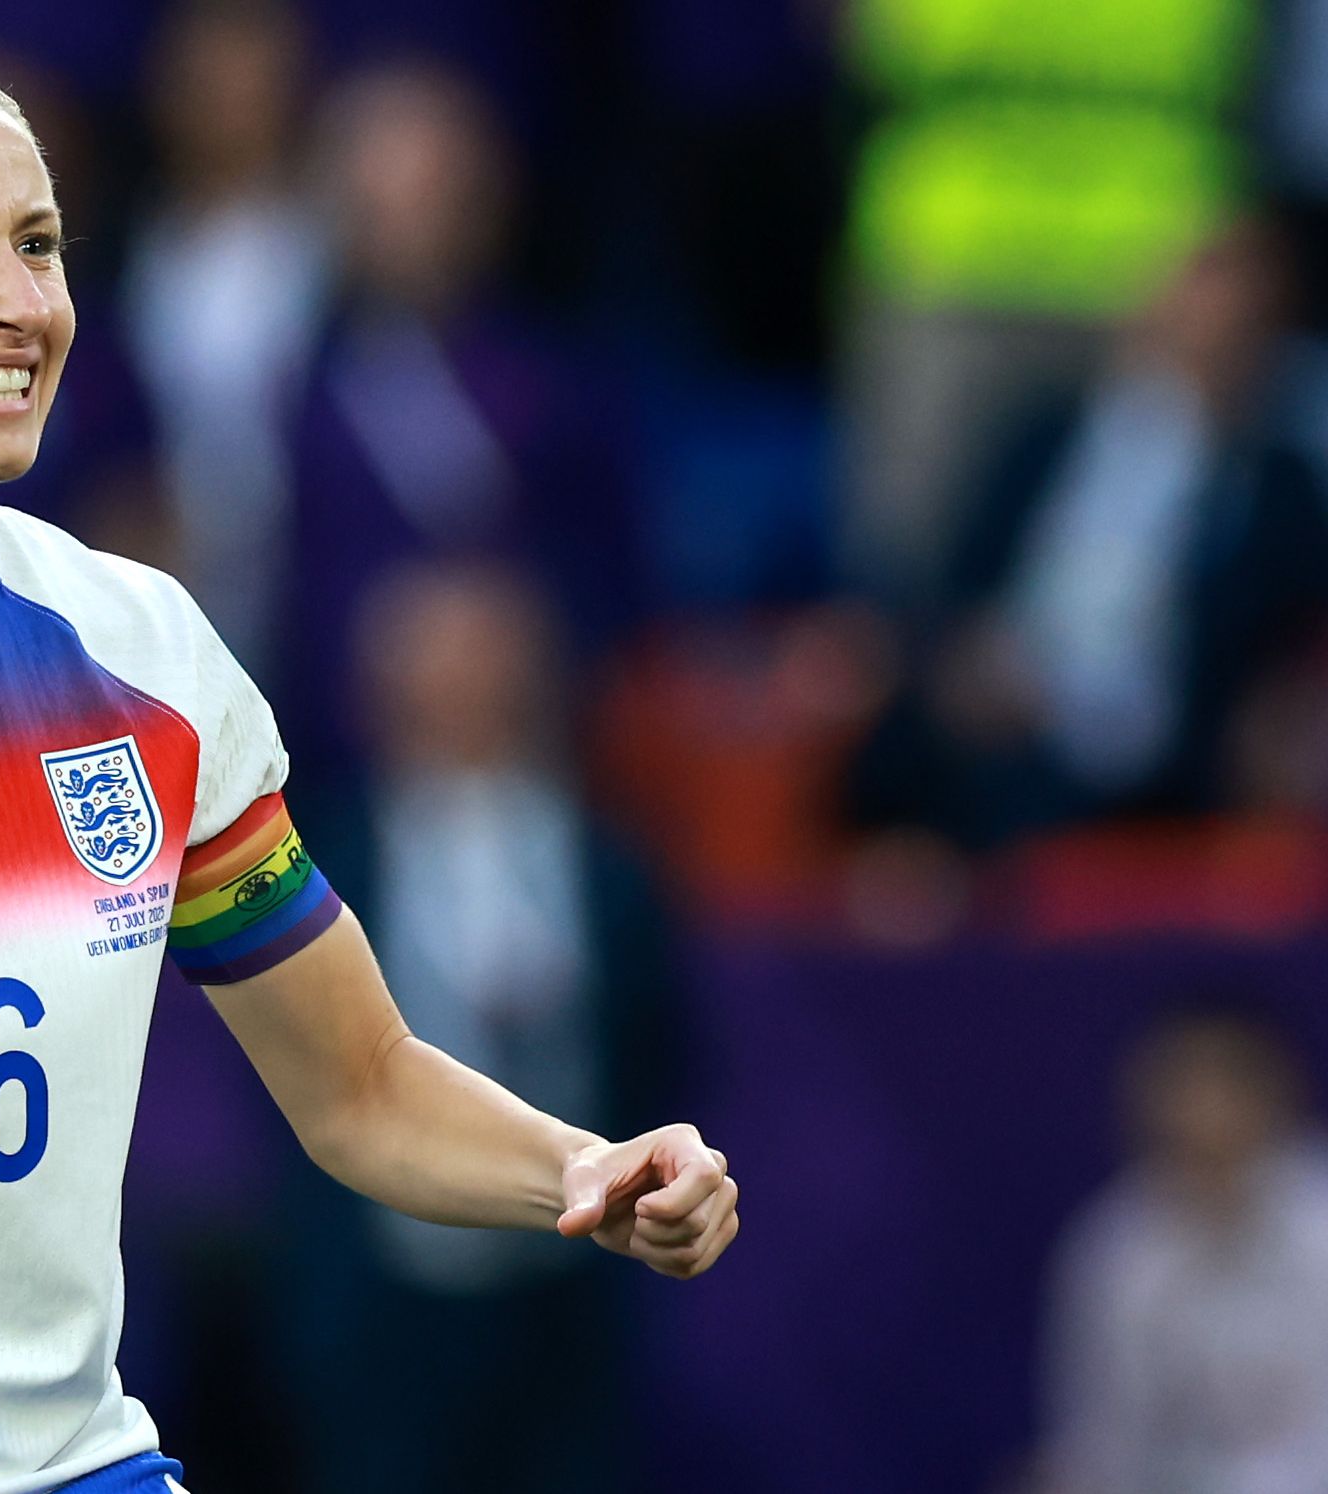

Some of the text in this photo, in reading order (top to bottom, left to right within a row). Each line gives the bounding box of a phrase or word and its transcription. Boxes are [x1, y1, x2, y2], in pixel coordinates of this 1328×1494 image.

[94, 893, 136, 914] ENGLAND
[147, 883, 169, 902] SPAIN
[107, 905, 165, 932] 27 JULY 2025
[86, 940, 111, 957] UEFA
[109, 931, 148, 952] WOMENS
